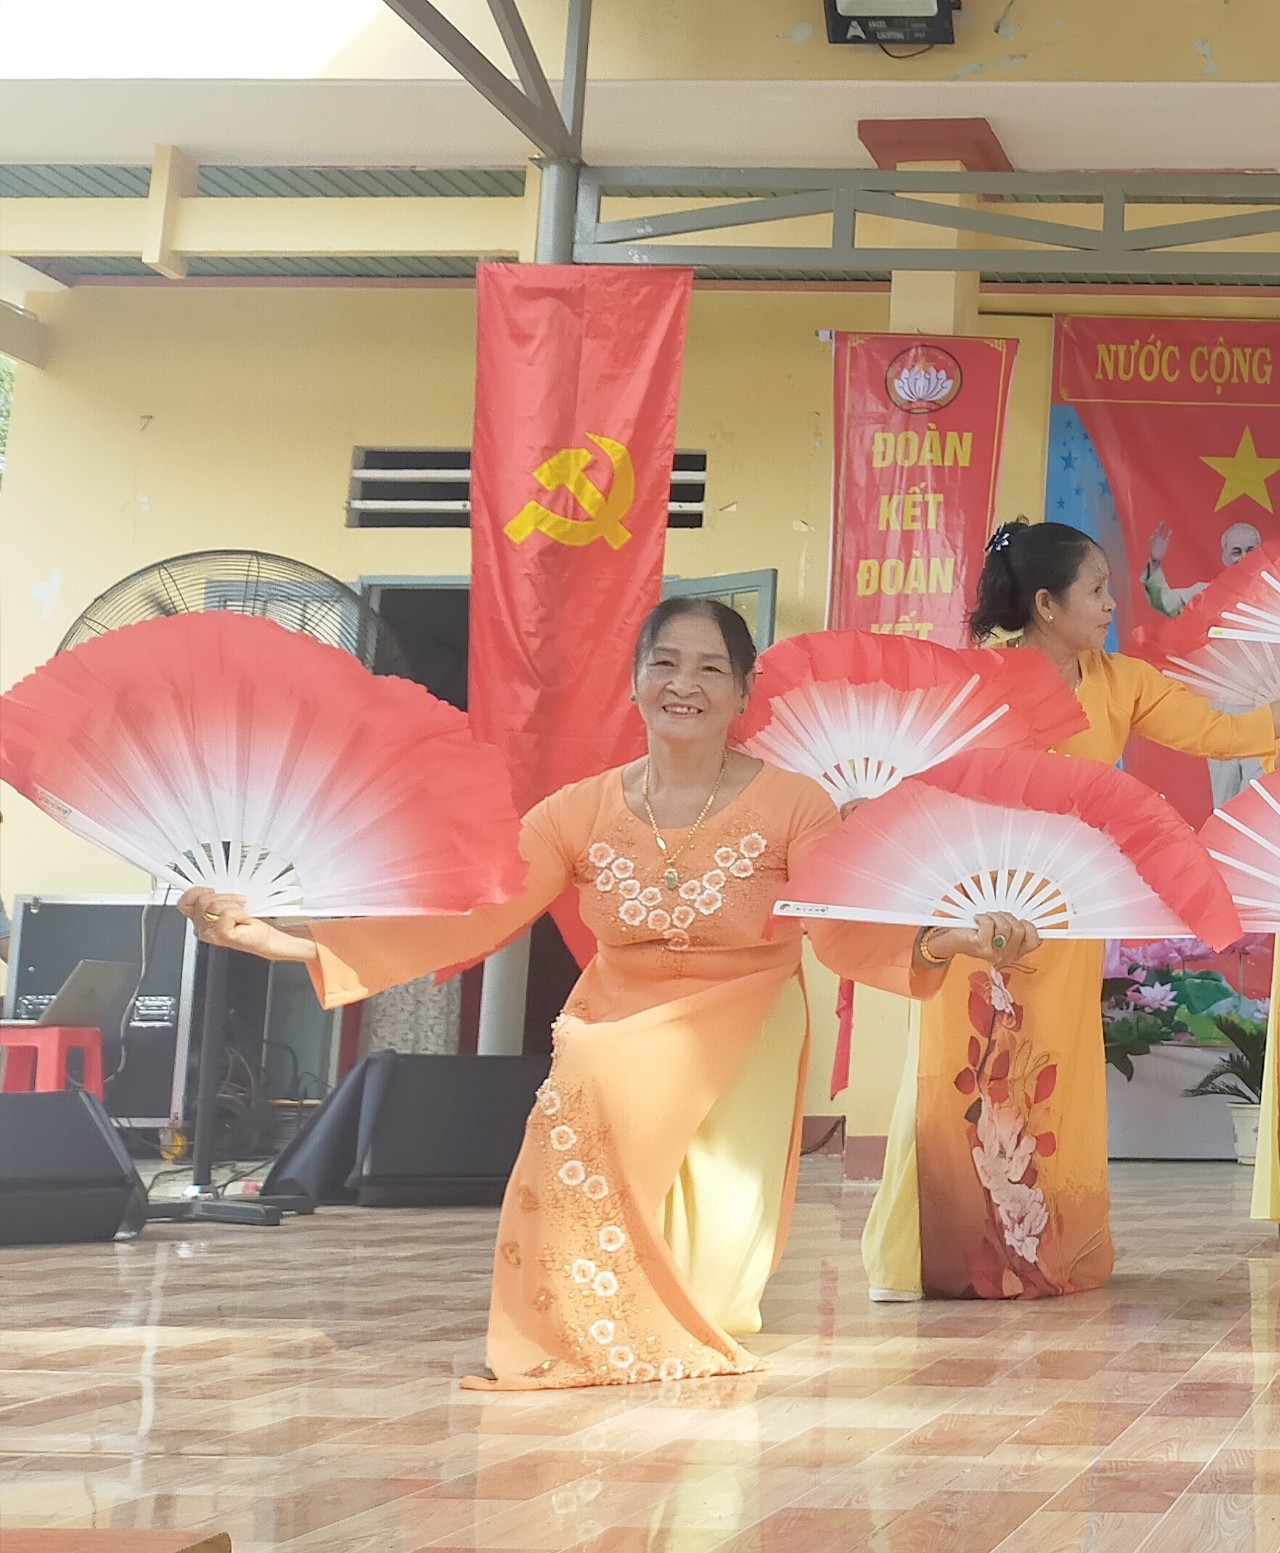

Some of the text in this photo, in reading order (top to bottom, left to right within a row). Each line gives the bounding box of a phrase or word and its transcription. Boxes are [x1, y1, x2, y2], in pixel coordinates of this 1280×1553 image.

[1095, 333, 1180, 382] NƯỚC
[1190, 336, 1273, 395] CỘNG
[872, 423, 973, 468] ĐOÀN
[878, 482, 944, 531] KẾT
[857, 550, 955, 596] ĐOÀN
